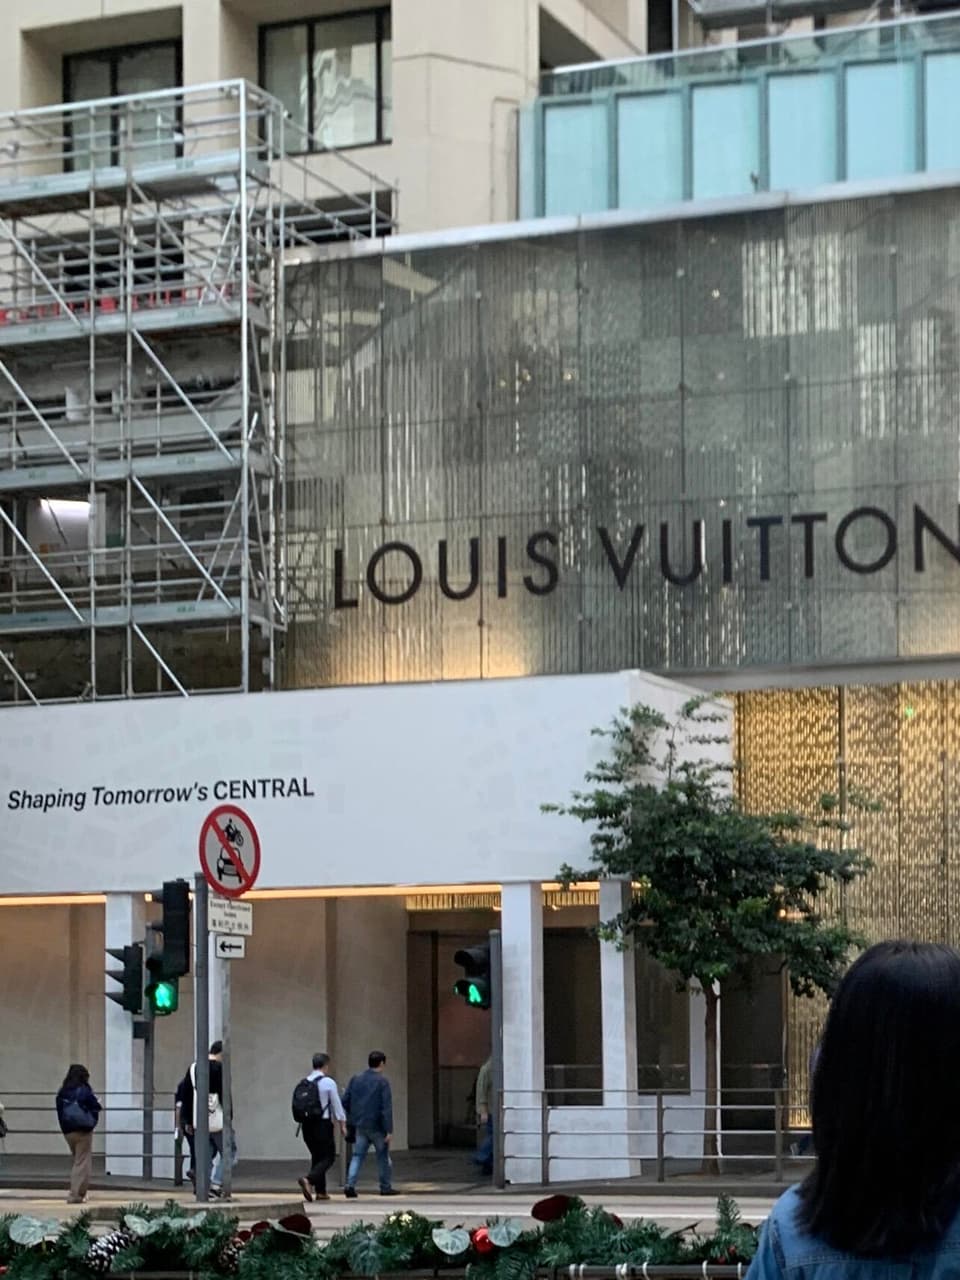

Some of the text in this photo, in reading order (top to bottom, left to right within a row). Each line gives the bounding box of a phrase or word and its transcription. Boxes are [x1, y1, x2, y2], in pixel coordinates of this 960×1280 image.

[334, 530, 559, 609] LOUIS
[7, 788, 87, 813] Shaping
[213, 777, 315, 801] CENTRAL
